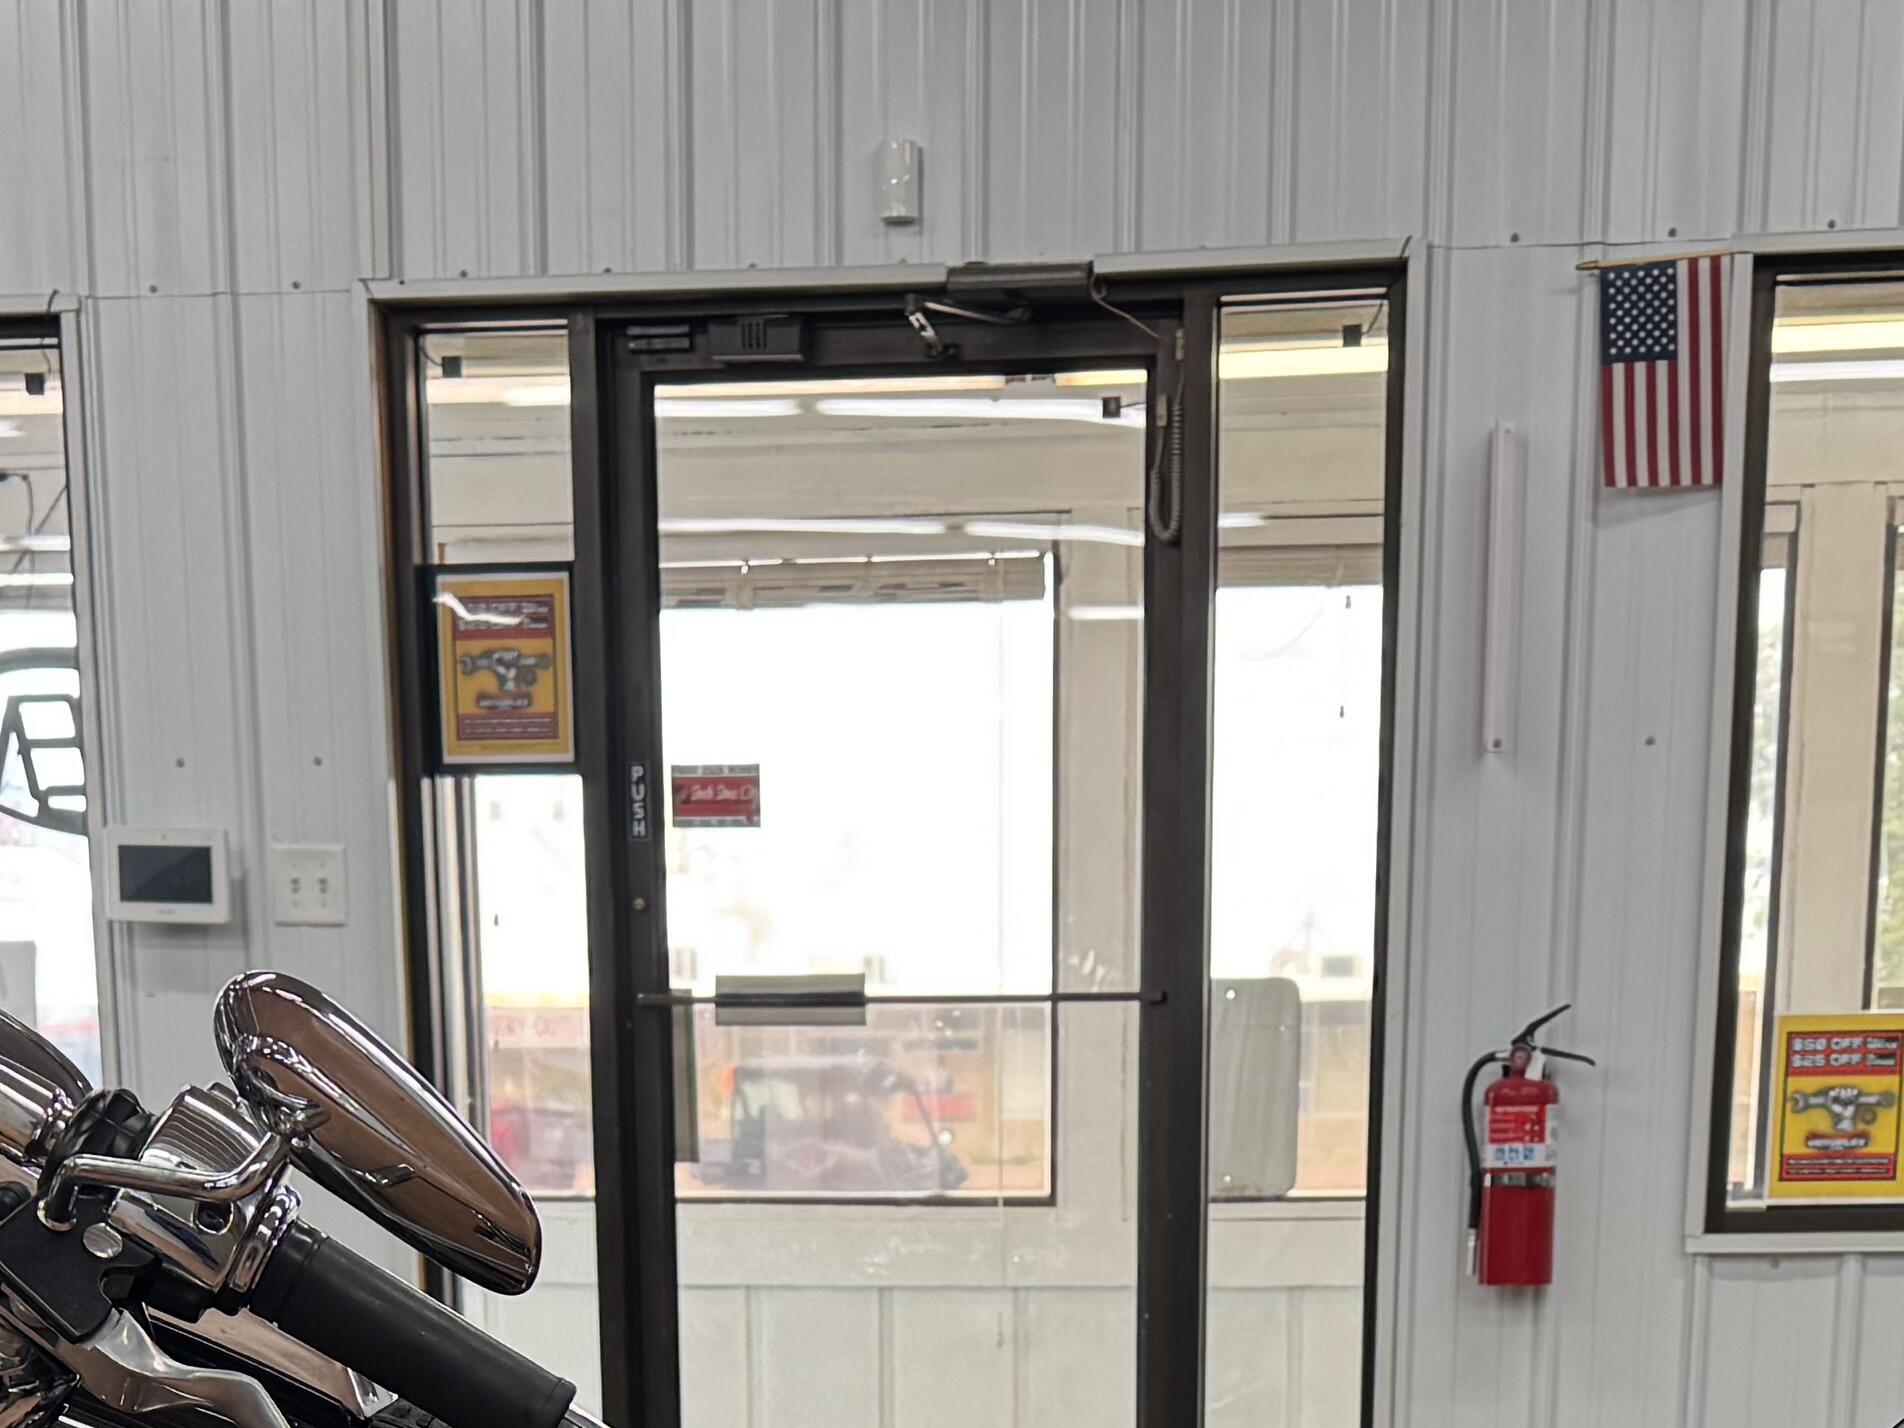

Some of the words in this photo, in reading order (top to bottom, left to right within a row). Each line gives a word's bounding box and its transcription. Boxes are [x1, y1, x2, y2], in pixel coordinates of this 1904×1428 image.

[631, 765, 647, 837] PUSH
[1830, 1037, 1864, 1050] OFF
[1829, 1053, 1862, 1066] OFF
